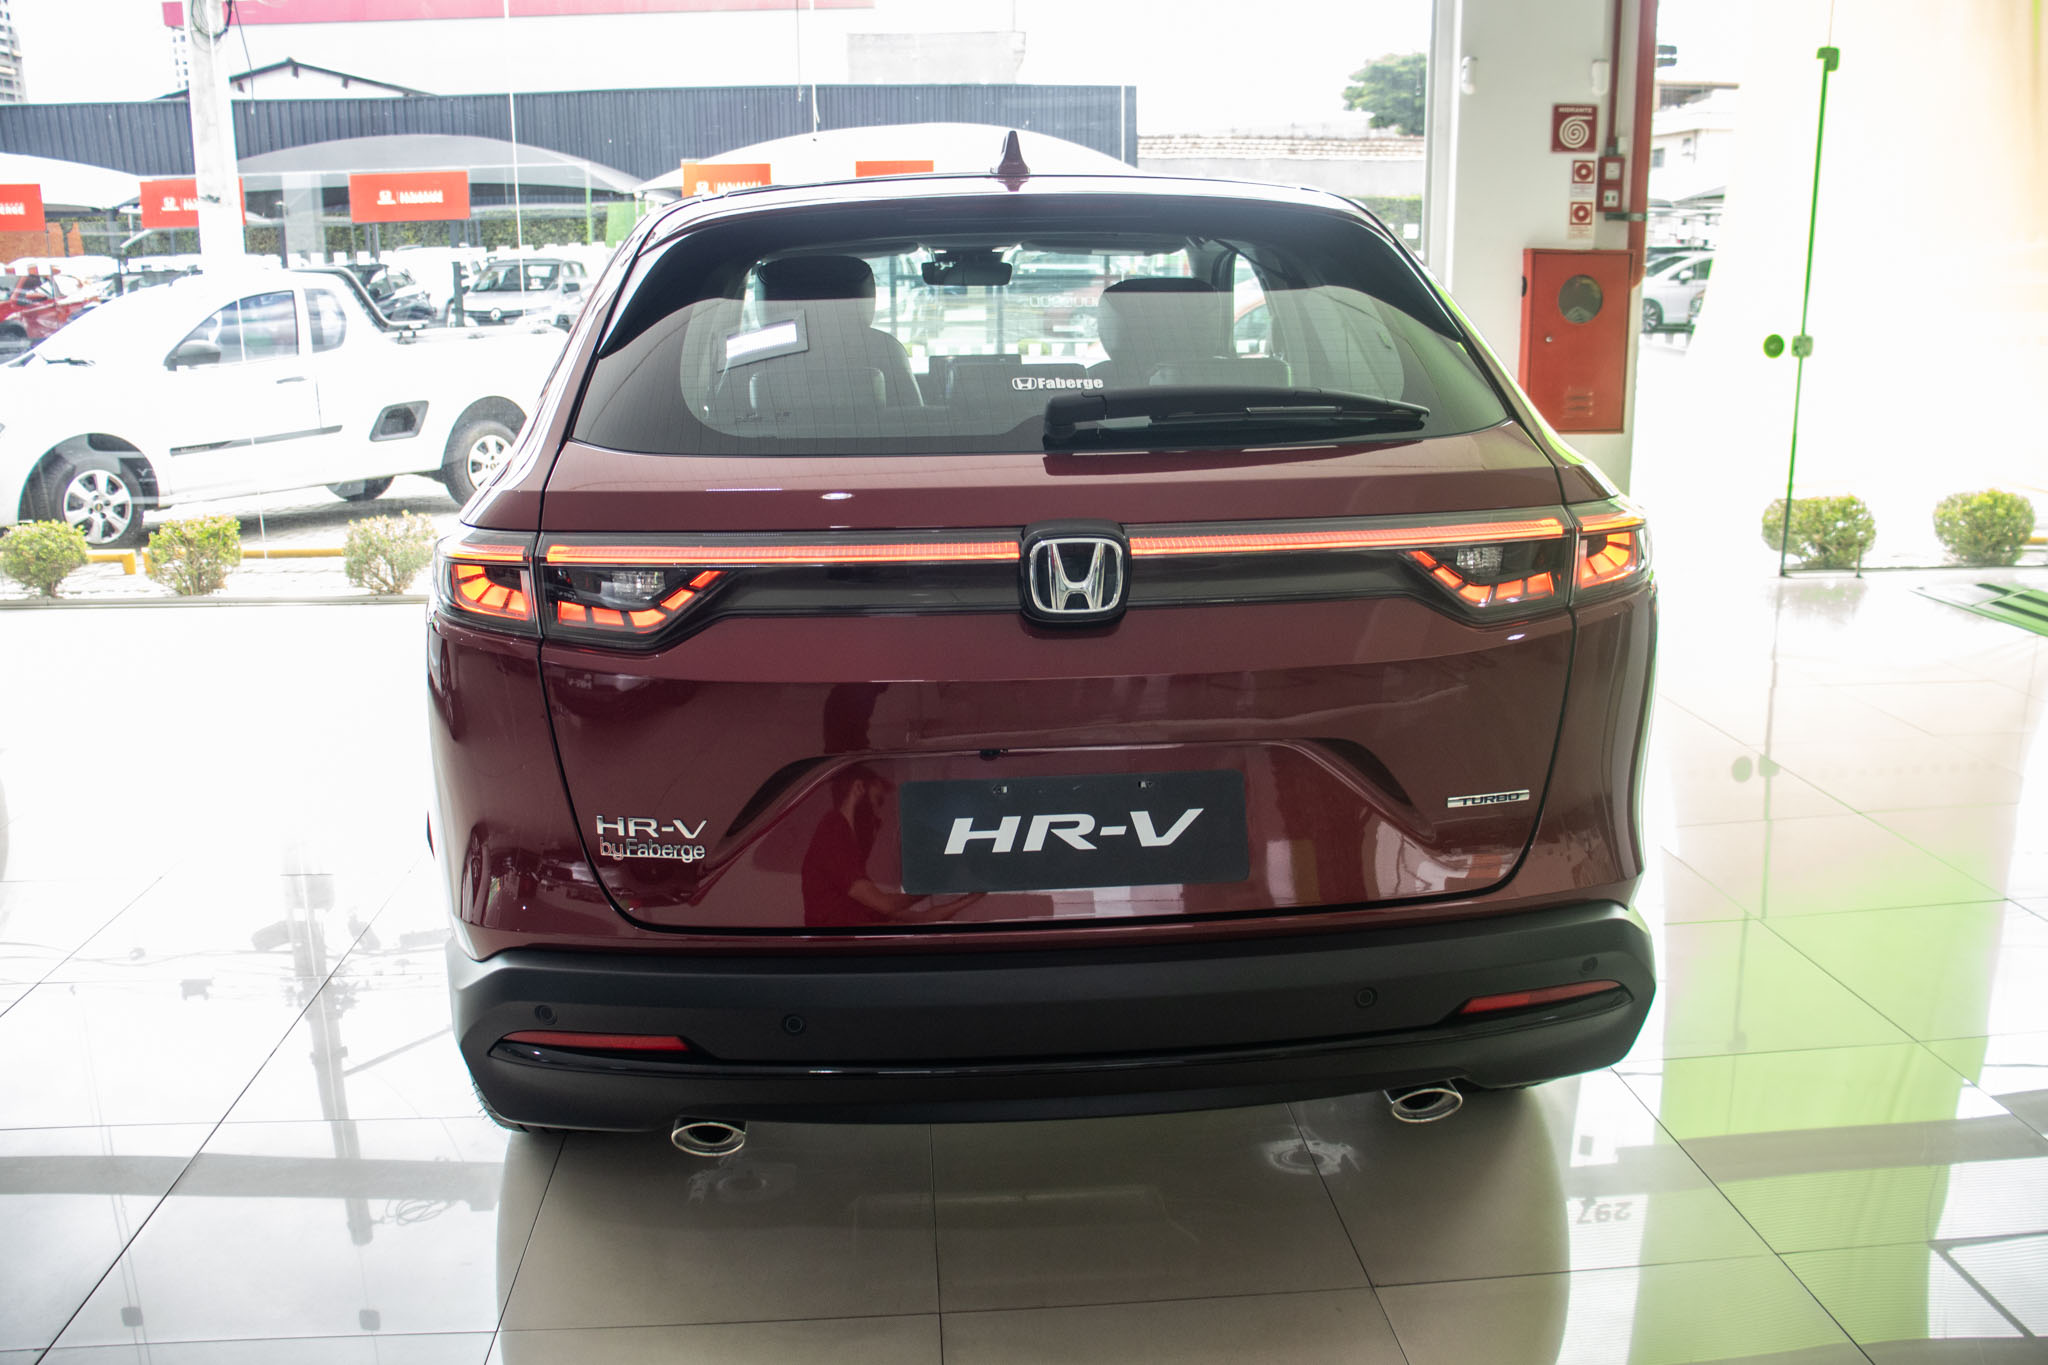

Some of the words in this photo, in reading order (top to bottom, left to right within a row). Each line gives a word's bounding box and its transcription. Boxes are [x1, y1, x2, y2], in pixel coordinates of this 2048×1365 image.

[1037, 377, 1104, 390] Faberge
[1460, 793, 1520, 806] TURBO
[596, 815, 708, 840] HR-V
[944, 807, 1204, 855] HR-V
